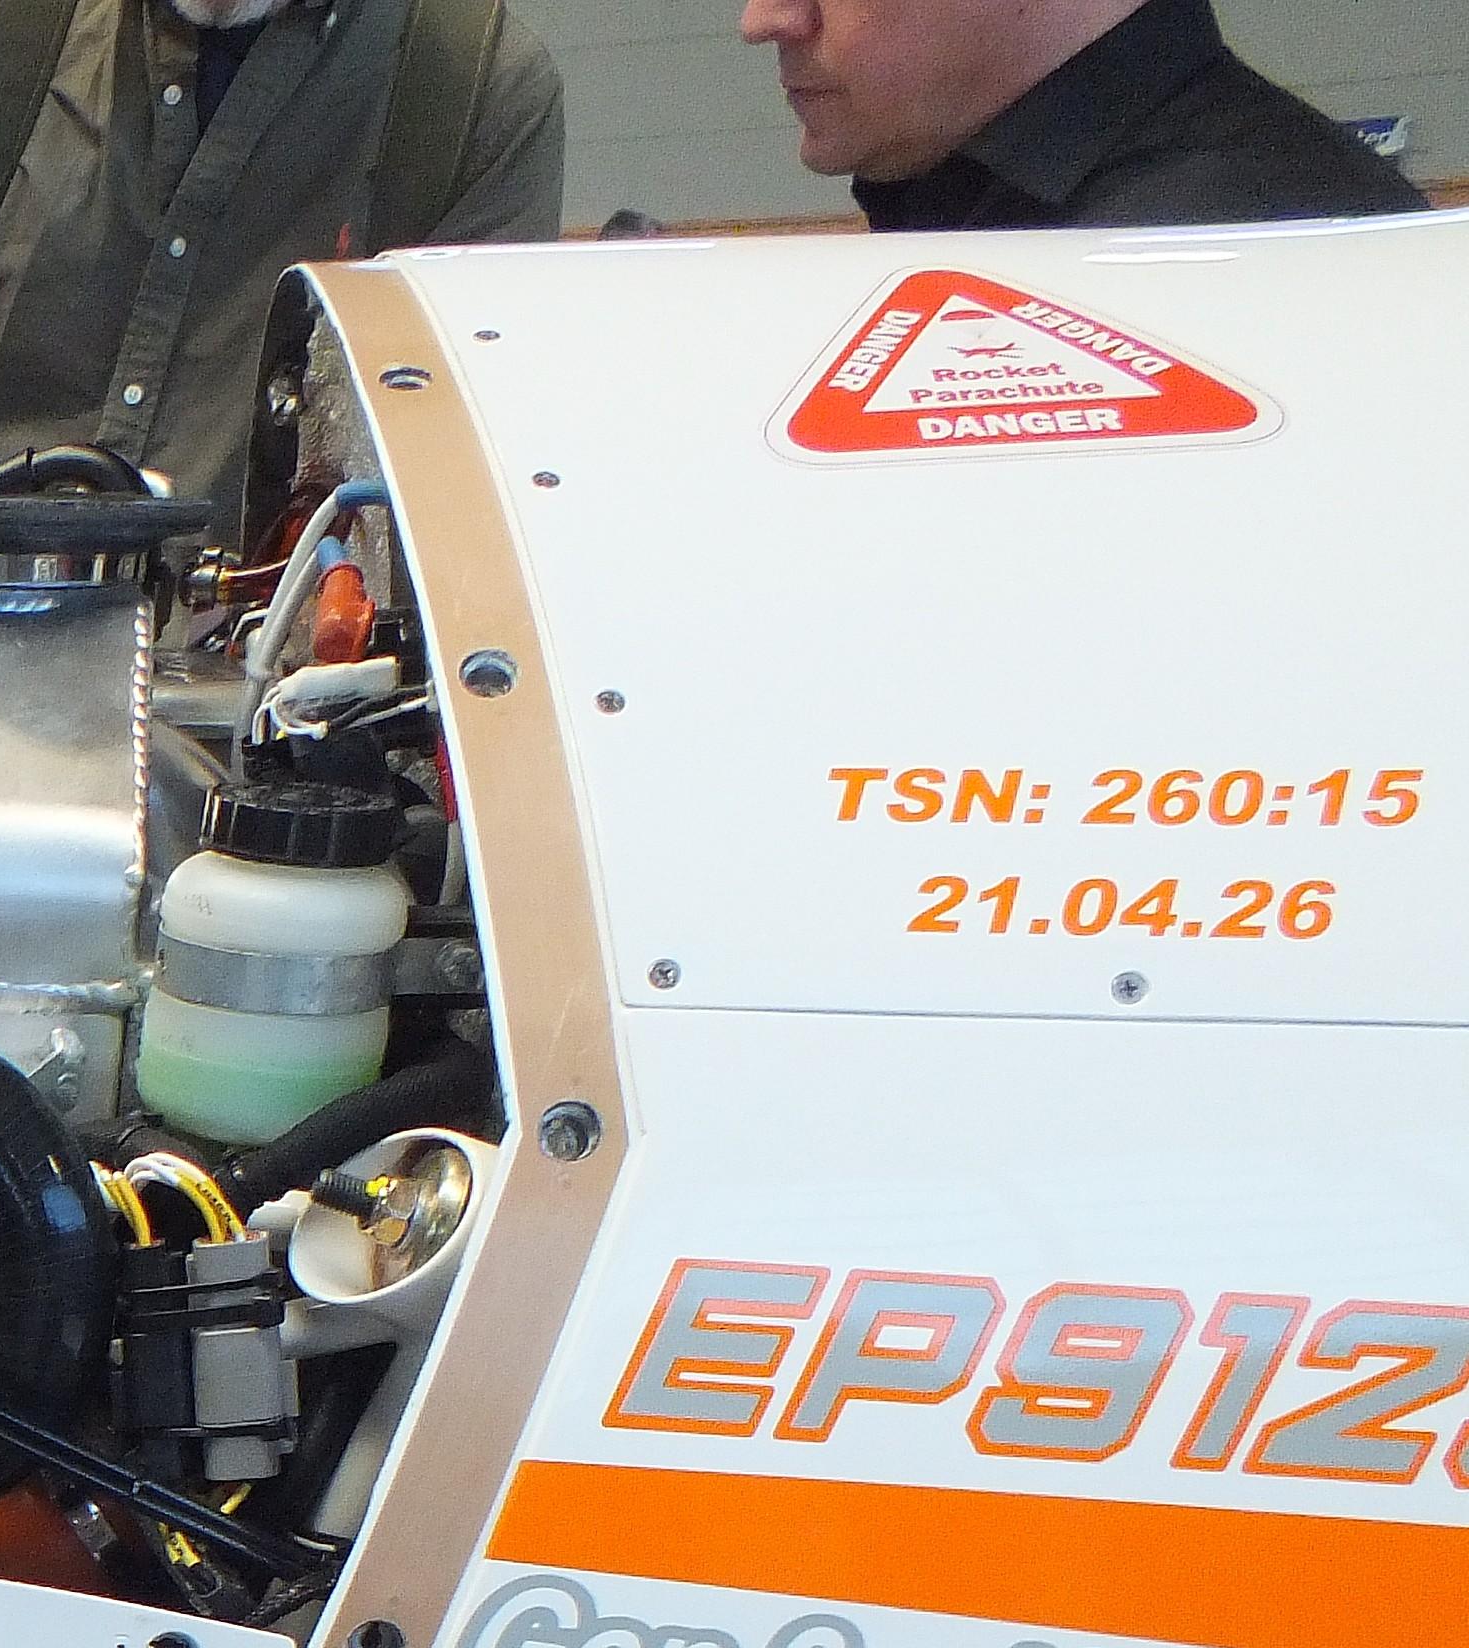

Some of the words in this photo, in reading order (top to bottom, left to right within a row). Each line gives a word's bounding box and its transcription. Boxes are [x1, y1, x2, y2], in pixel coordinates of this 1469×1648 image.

[829, 309, 923, 393] DANGER
[1011, 301, 1172, 377] DANGER
[909, 379, 1104, 404] Parachute
[932, 362, 1066, 383] Rocket
[917, 407, 1124, 440] DANGER
[828, 768, 1051, 824] TSN:
[1080, 768, 1425, 827] 260:15
[906, 876, 1338, 940] 21.04.26
[602, 1257, 1469, 1491] EP912
